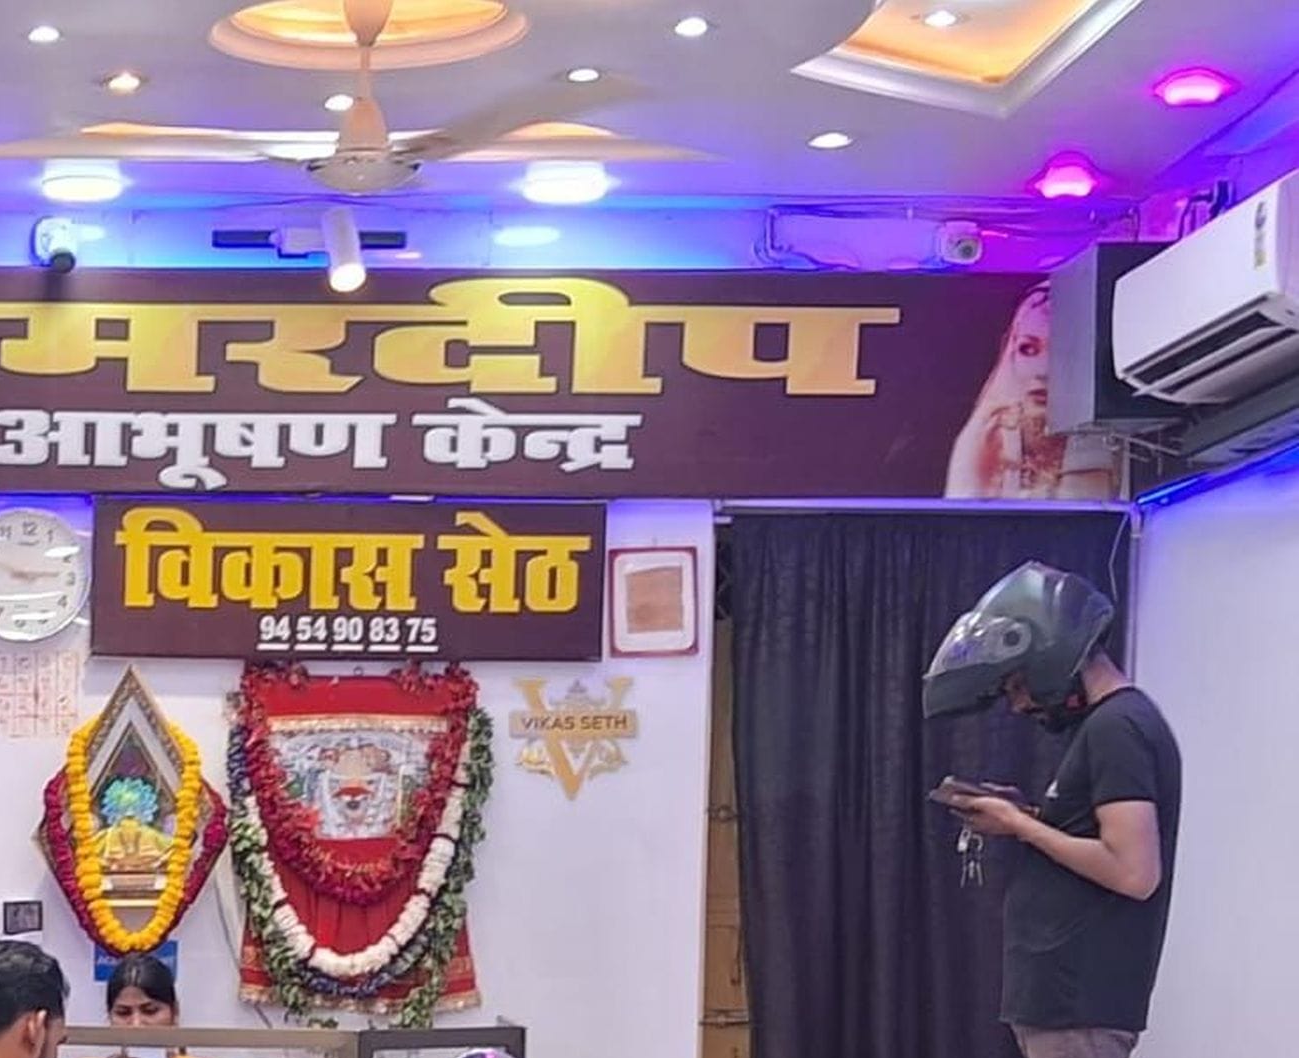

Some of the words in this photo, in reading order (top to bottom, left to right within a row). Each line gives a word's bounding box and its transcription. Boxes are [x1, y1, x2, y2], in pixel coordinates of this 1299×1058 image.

[410, 397, 644, 473] केन्द्र
[113, 507, 425, 612] विकास
[435, 511, 592, 614] सेठ
[259, 615, 291, 642] 94
[296, 615, 328, 642] 54
[332, 615, 364, 642] 90
[368, 616, 400, 643] 83
[405, 617, 438, 643] 75
[521, 714, 576, 731] VIKAS
[579, 714, 629, 731] SETH
